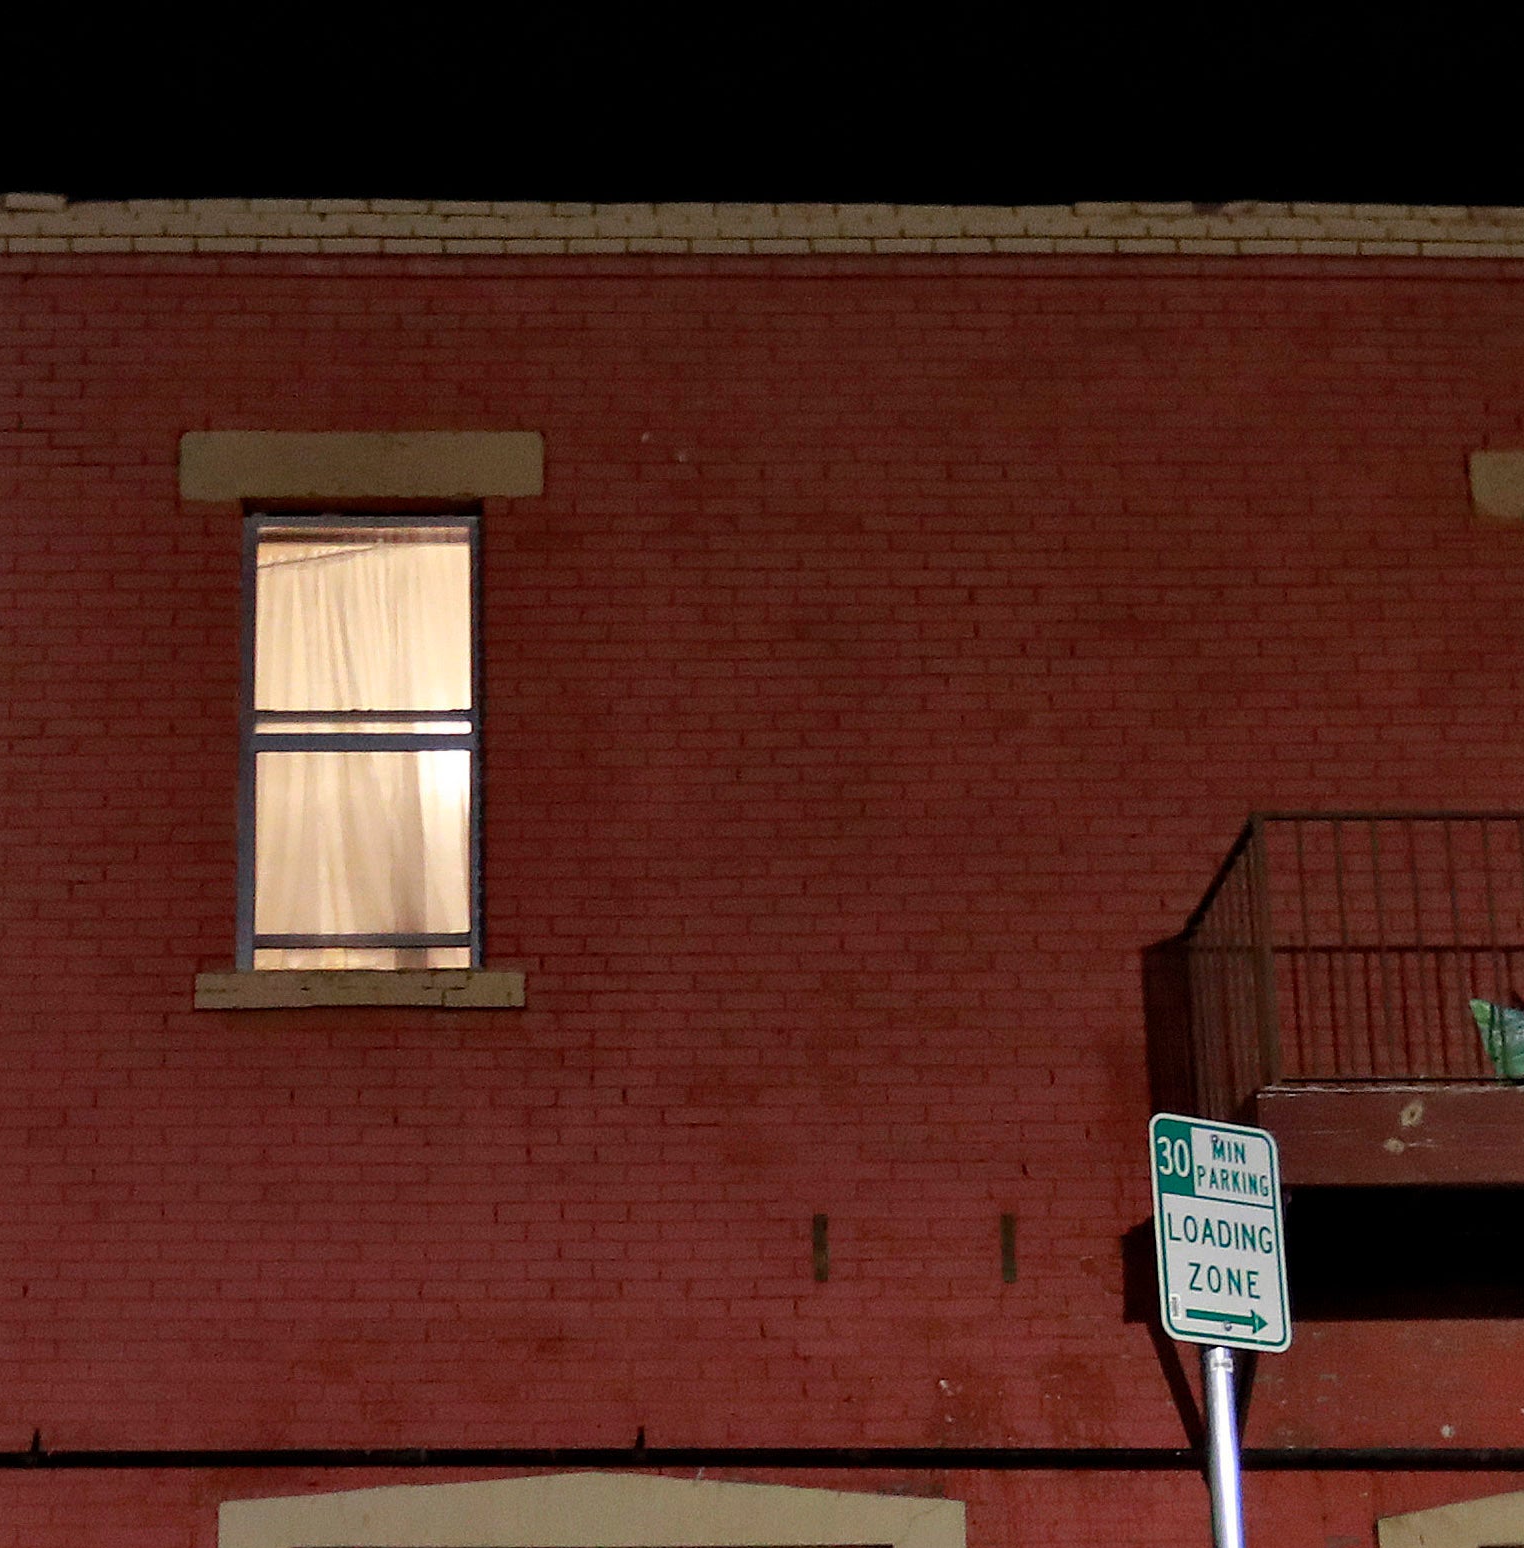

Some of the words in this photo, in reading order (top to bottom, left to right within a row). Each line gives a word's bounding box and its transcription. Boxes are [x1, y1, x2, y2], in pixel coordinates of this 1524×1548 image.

[1157, 1135, 1191, 1178] 30
[1211, 1140, 1247, 1165] MIN
[1196, 1165, 1270, 1198] PARKING
[1167, 1212, 1273, 1255] LOADING
[1188, 1262, 1261, 1300] ZONE
